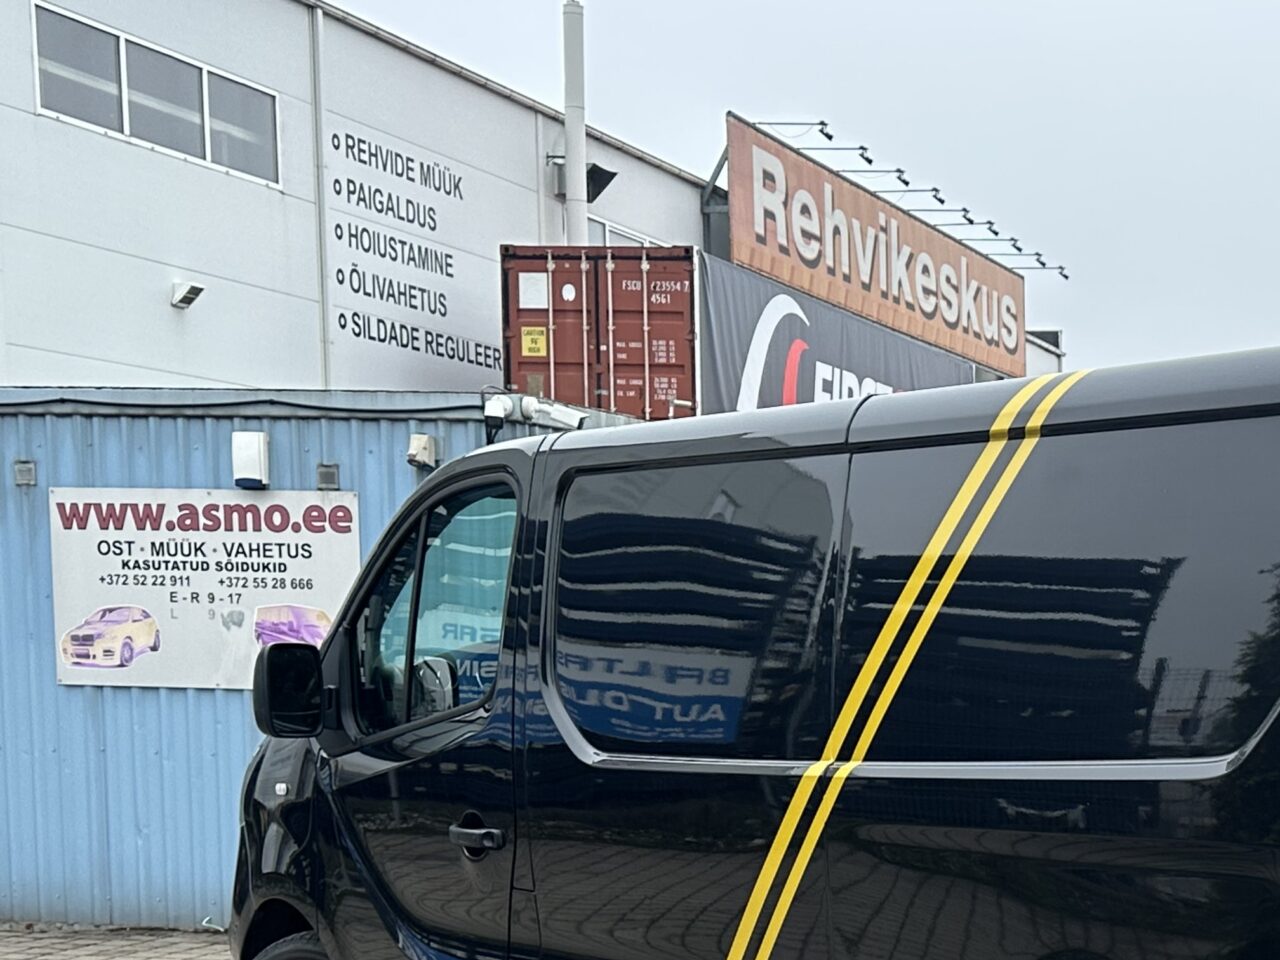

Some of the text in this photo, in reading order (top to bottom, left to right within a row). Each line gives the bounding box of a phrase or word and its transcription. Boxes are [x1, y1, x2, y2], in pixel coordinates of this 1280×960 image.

[345, 133, 464, 200] REHVIDE MÜÜK
[346, 178, 437, 231] PAIGALDUS
[347, 222, 454, 278] HOIUSTAMINE
[752, 145, 1018, 353] Rehvikeskus
[349, 262, 447, 317] ÕLIVAHETUS
[351, 312, 420, 352] SILDADE
[56, 502, 353, 533] www.asmo.ee
[97, 538, 312, 559] OST MÜÜK VAHETUS
[121, 558, 288, 573] KASUTATUD SÕIDUKID
[99, 574, 190, 587] +372 52 22 911
[218, 577, 313, 590] +372 55 28 666
